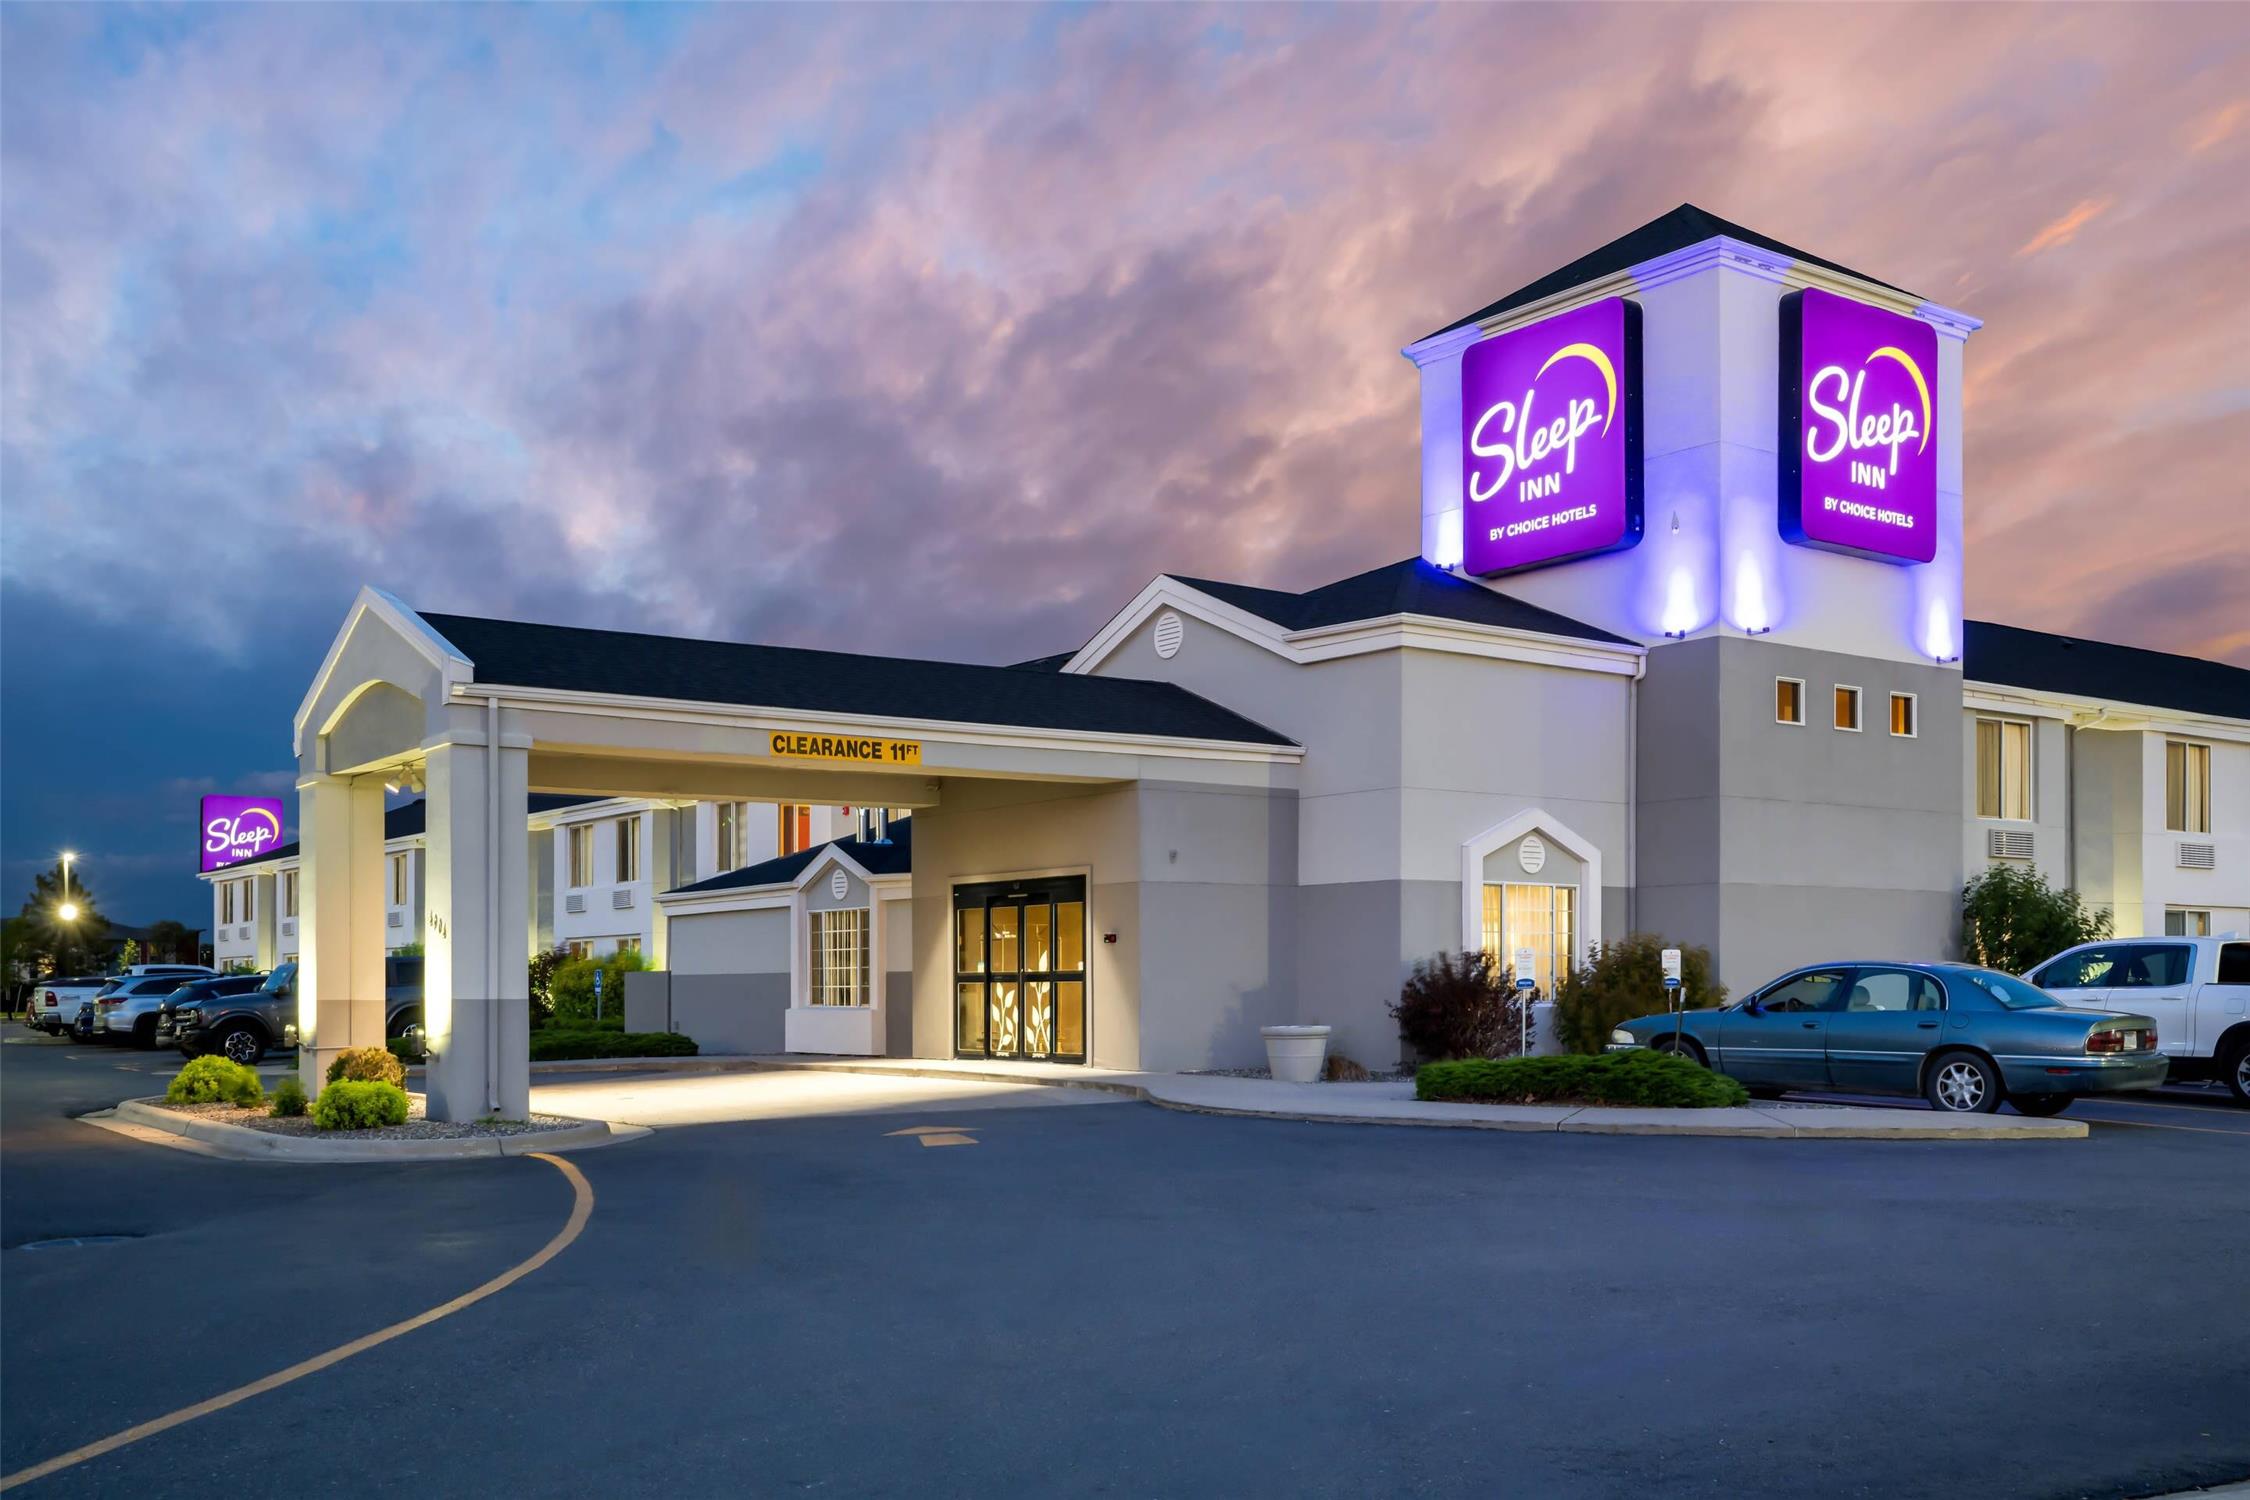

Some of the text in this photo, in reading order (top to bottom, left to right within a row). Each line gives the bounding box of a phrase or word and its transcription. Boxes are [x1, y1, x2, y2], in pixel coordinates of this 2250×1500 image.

[1807, 365, 1919, 476] Sleep
[1469, 389, 1602, 502] Sleep
[1520, 472, 1561, 502] INN
[1851, 460, 1886, 490] INN
[1489, 504, 1597, 541] BY CHOICE HOTELS
[1824, 496, 1914, 528] BY CHOICE HOTELS
[772, 735, 882, 760] CLEARANCE
[206, 817, 273, 852] Sleep
[232, 848, 253, 858] INN
